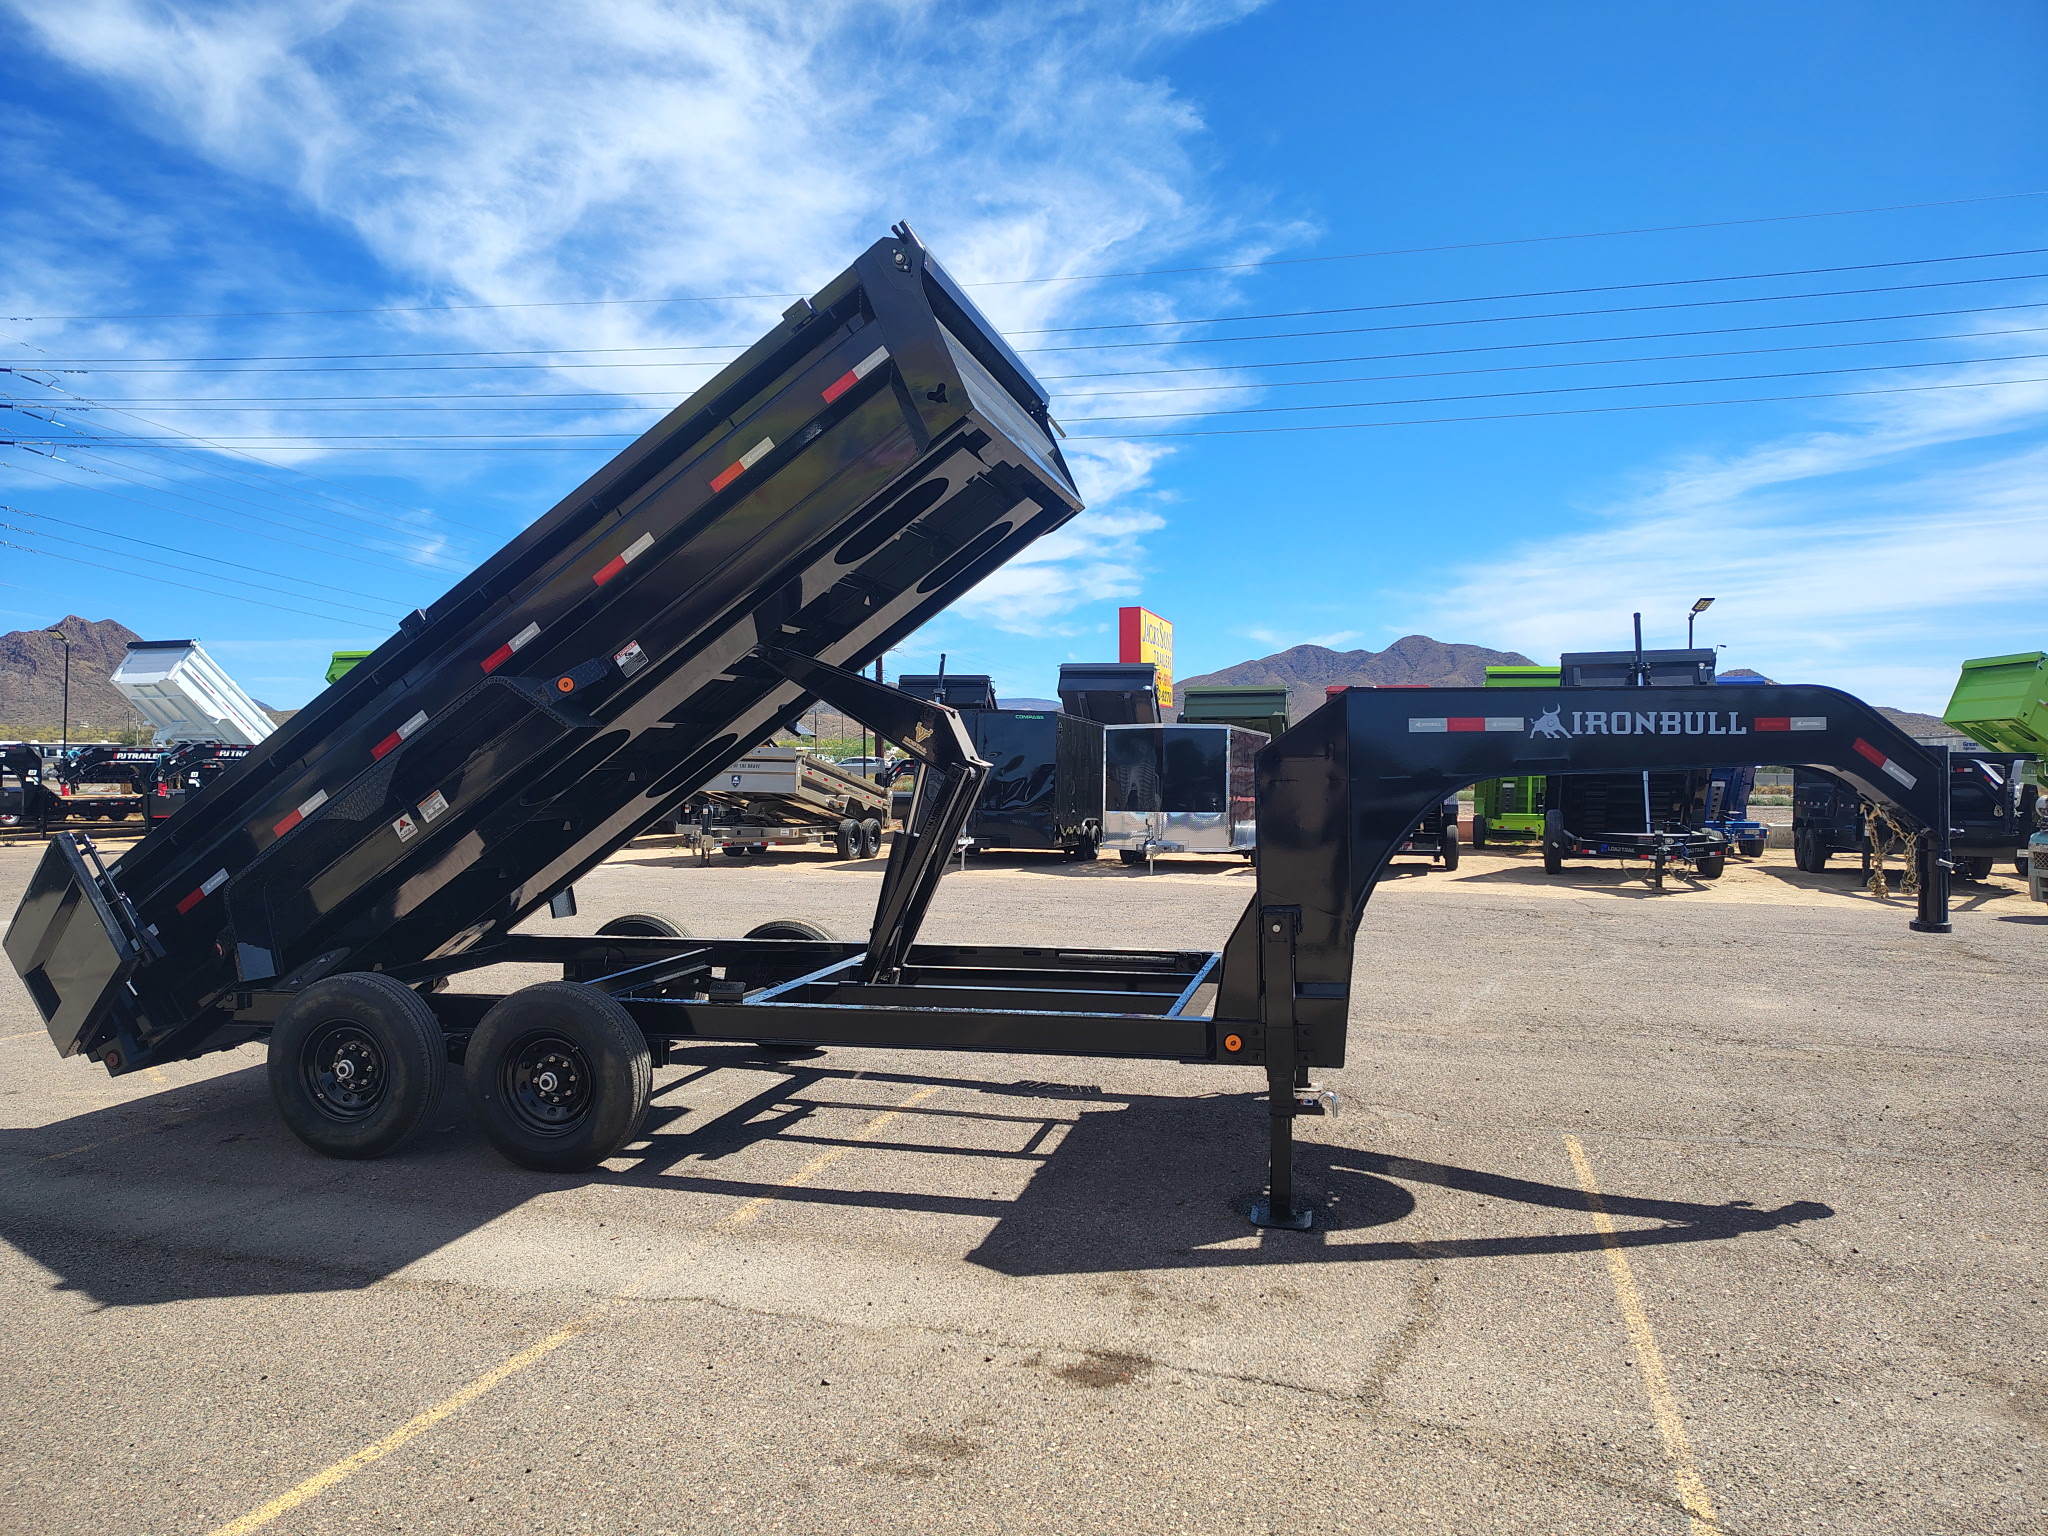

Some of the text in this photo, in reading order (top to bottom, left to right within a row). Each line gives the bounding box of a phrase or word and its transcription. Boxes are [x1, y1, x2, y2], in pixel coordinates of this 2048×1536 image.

[1571, 711, 1747, 735] IRONBULL
[117, 752, 161, 760] PJ TRAILE
[219, 749, 230, 757] PJ
